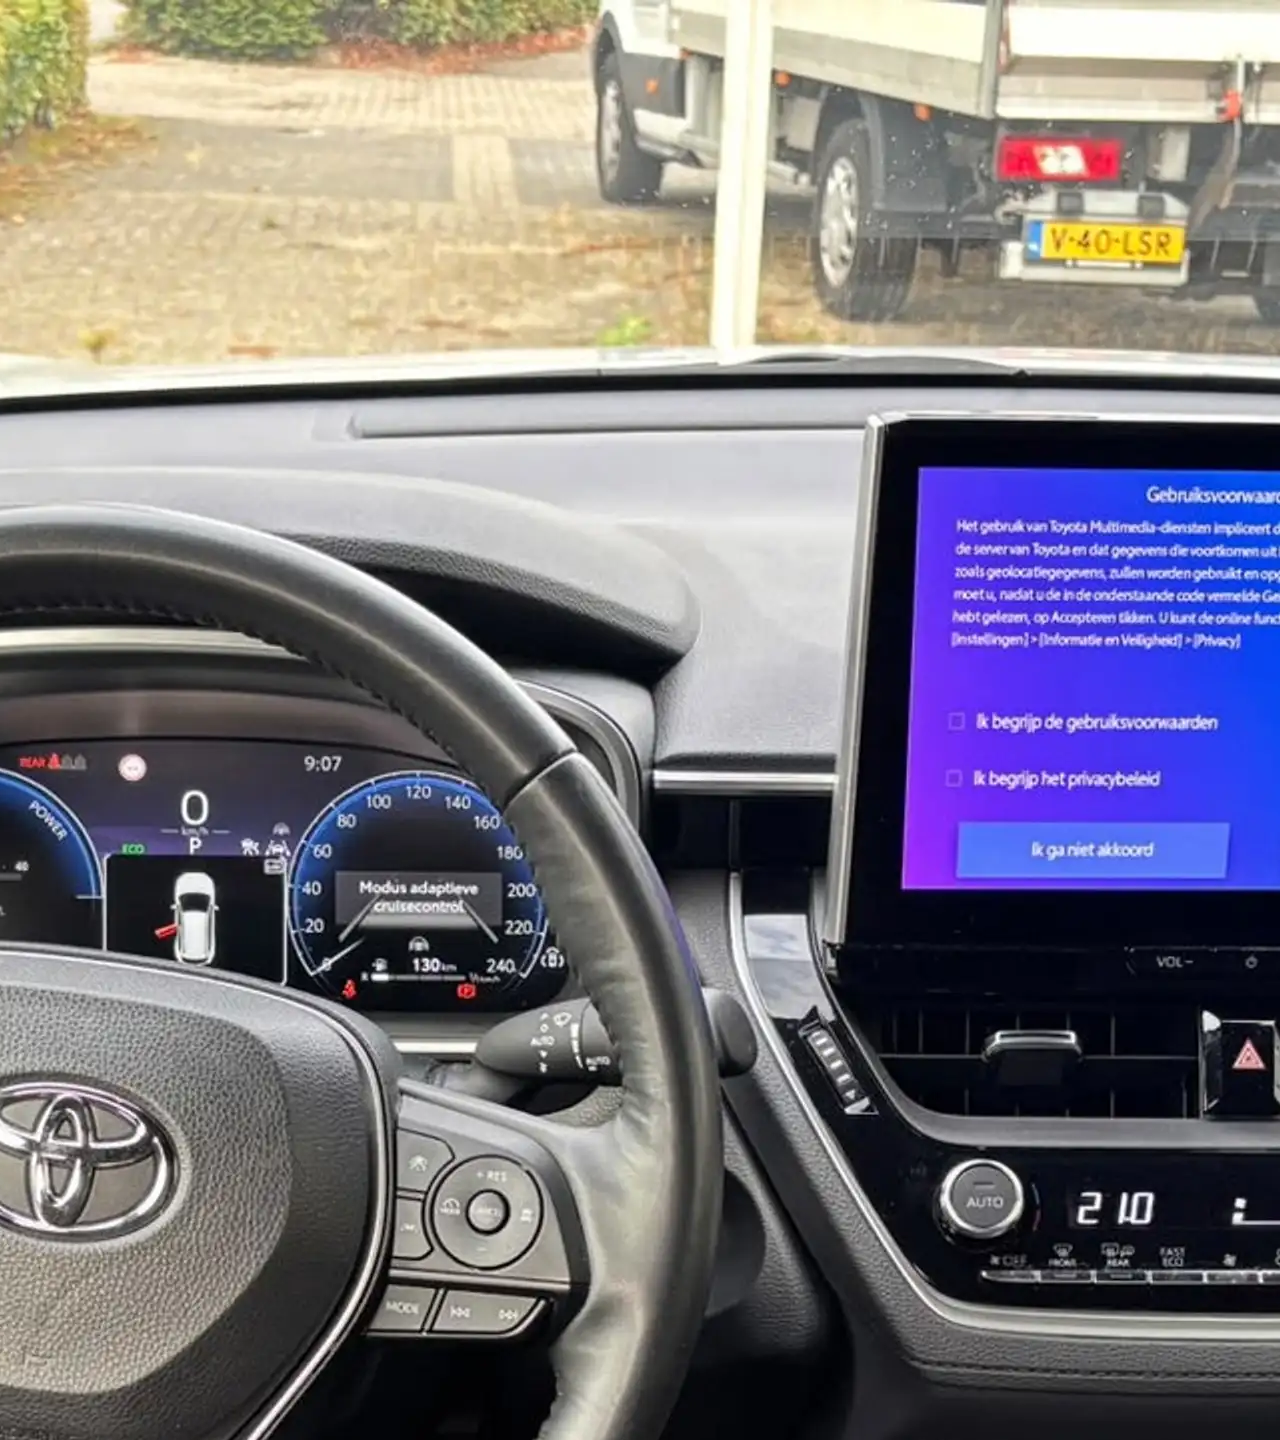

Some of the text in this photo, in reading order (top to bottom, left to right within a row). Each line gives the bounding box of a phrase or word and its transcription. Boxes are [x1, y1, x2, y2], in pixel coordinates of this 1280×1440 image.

[1051, 228, 1171, 257] V-40-LSR
[976, 713, 1219, 734] Ik begrijp de gebruiksvoorwaarden
[304, 756, 342, 772] 9:07
[973, 770, 1161, 790] Ik begrijp het privacybeleid
[406, 786, 431, 799] 120
[181, 790, 209, 825] 0
[366, 796, 391, 809] 100
[445, 796, 471, 809] 140
[28, 800, 68, 841] POWER
[337, 815, 357, 828] 80
[474, 815, 500, 829] 160
[122, 844, 145, 855] ECO
[189, 837, 202, 855] P
[313, 845, 331, 858] 60
[497, 846, 523, 860] 180
[1031, 842, 1154, 860] Ik ga niet akkoord
[302, 882, 321, 895] 40
[359, 880, 479, 897] Modus adaptieve
[507, 883, 536, 898] 200
[374, 899, 465, 913] cruisecontrol
[304, 919, 324, 933] 20
[504, 921, 533, 935] 220
[487, 959, 516, 973] 240
[530, 1036, 555, 1046] AUTO
[585, 1056, 611, 1065] AUTO
[966, 1197, 1004, 1208] AUTO
